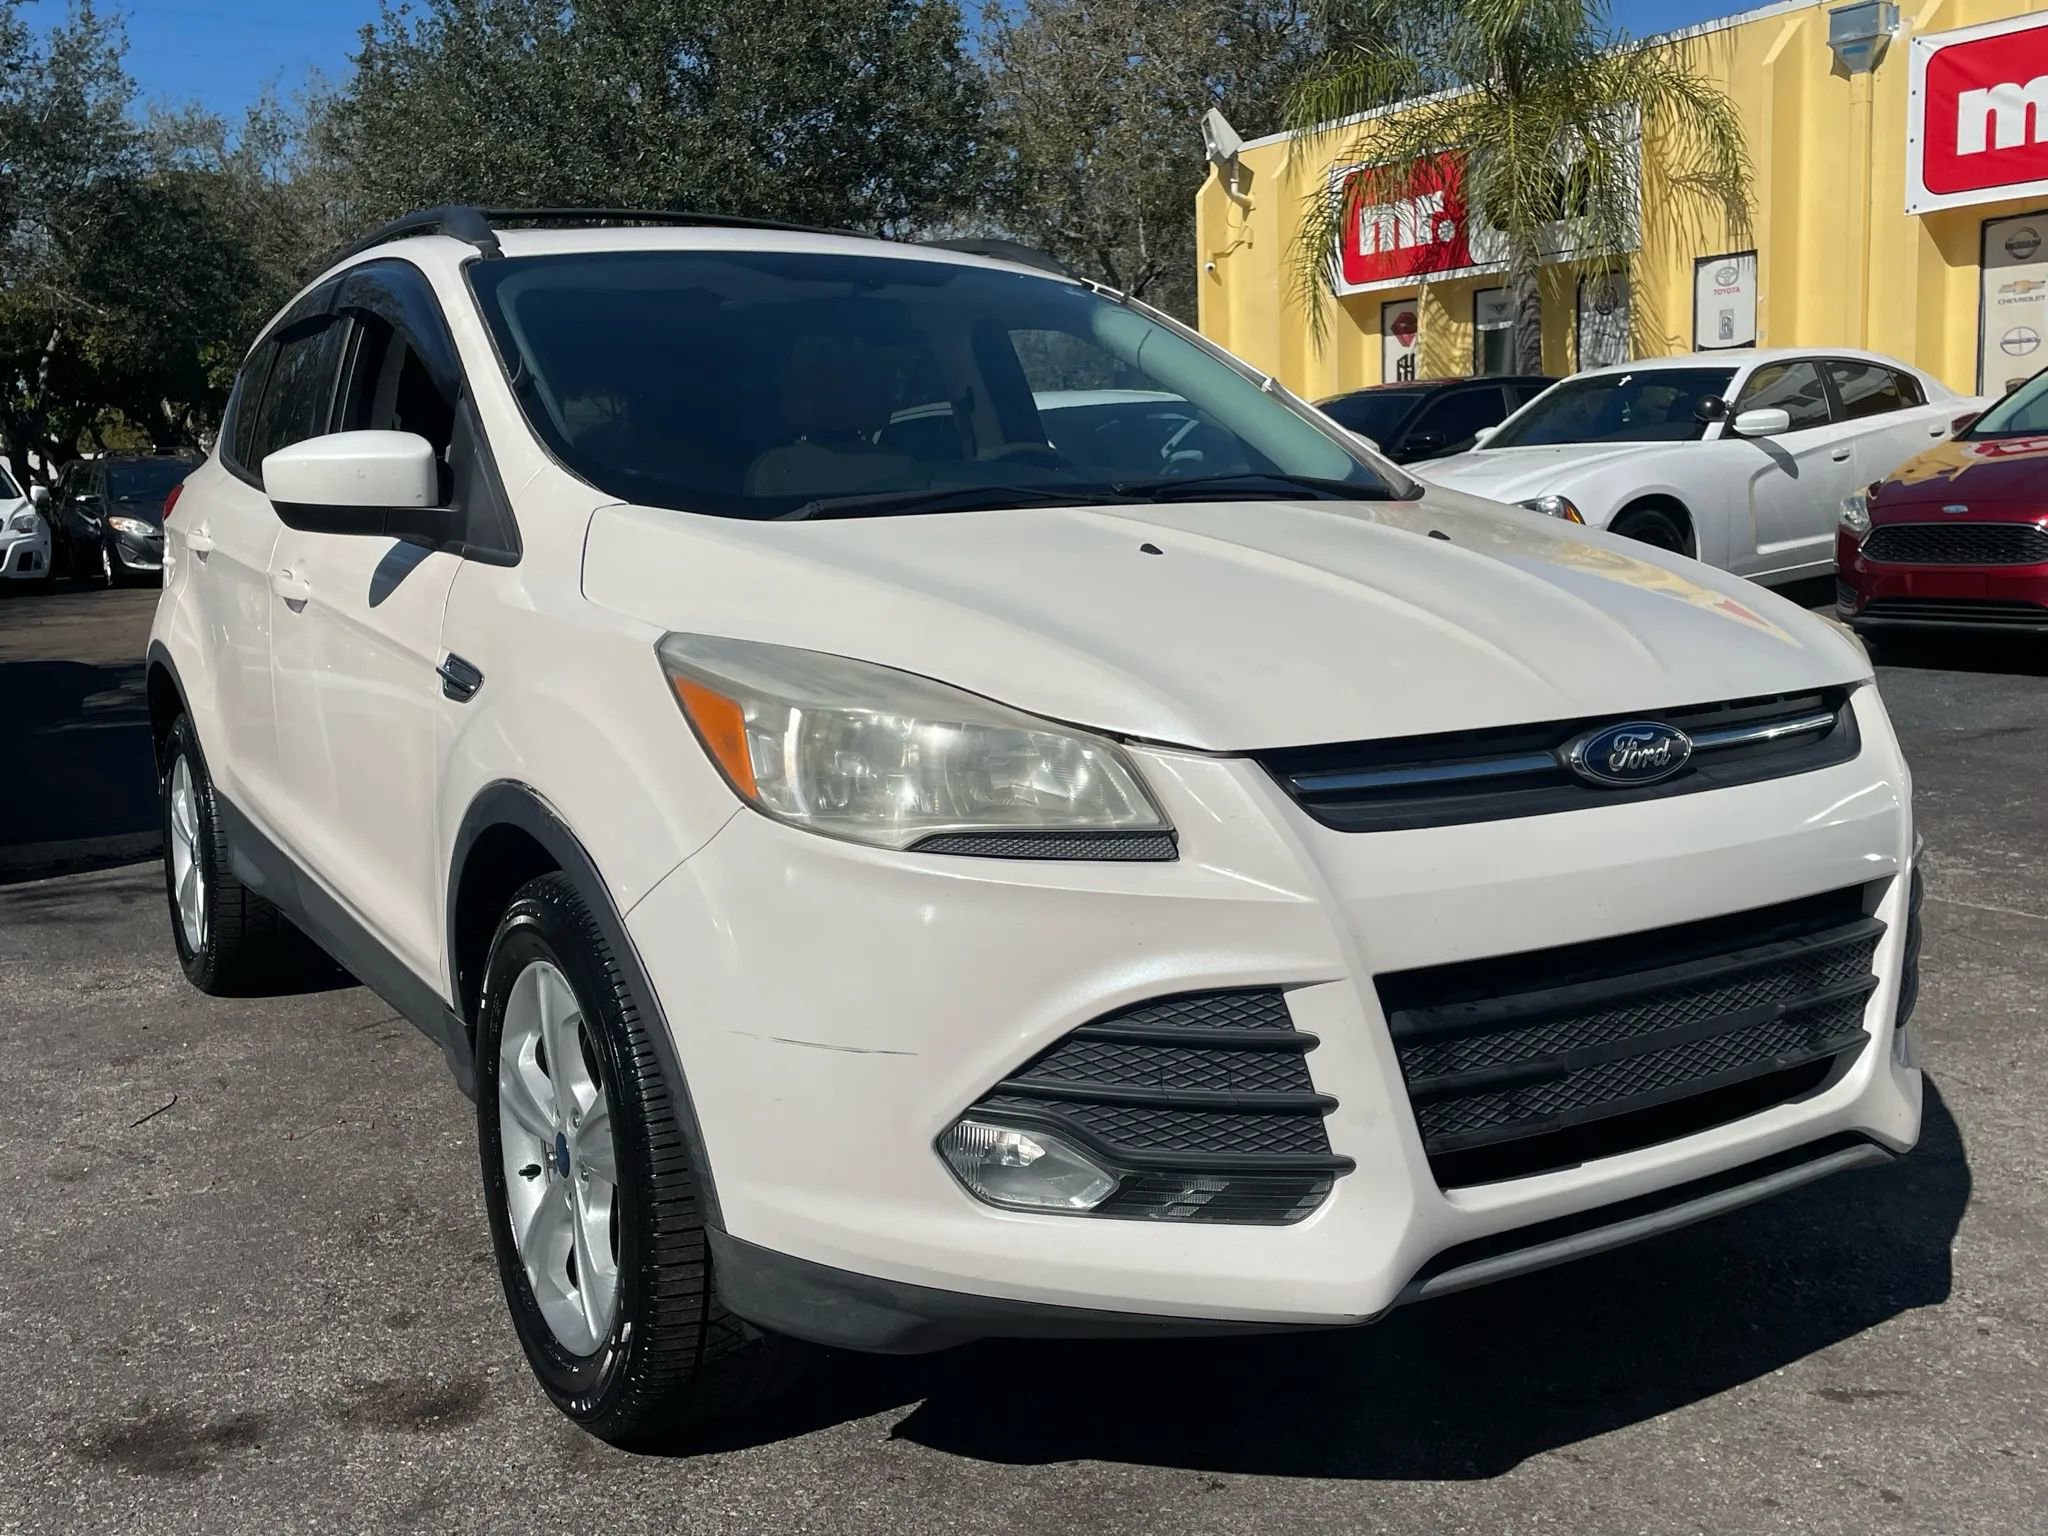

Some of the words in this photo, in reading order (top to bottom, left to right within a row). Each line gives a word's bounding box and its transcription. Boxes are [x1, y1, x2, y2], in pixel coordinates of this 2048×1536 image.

[1359, 190, 1456, 256] mr.
[1713, 287, 1741, 296] TOYOTA
[1997, 295, 2046, 305] CHEVROLET
[1608, 732, 1671, 772] Ford
